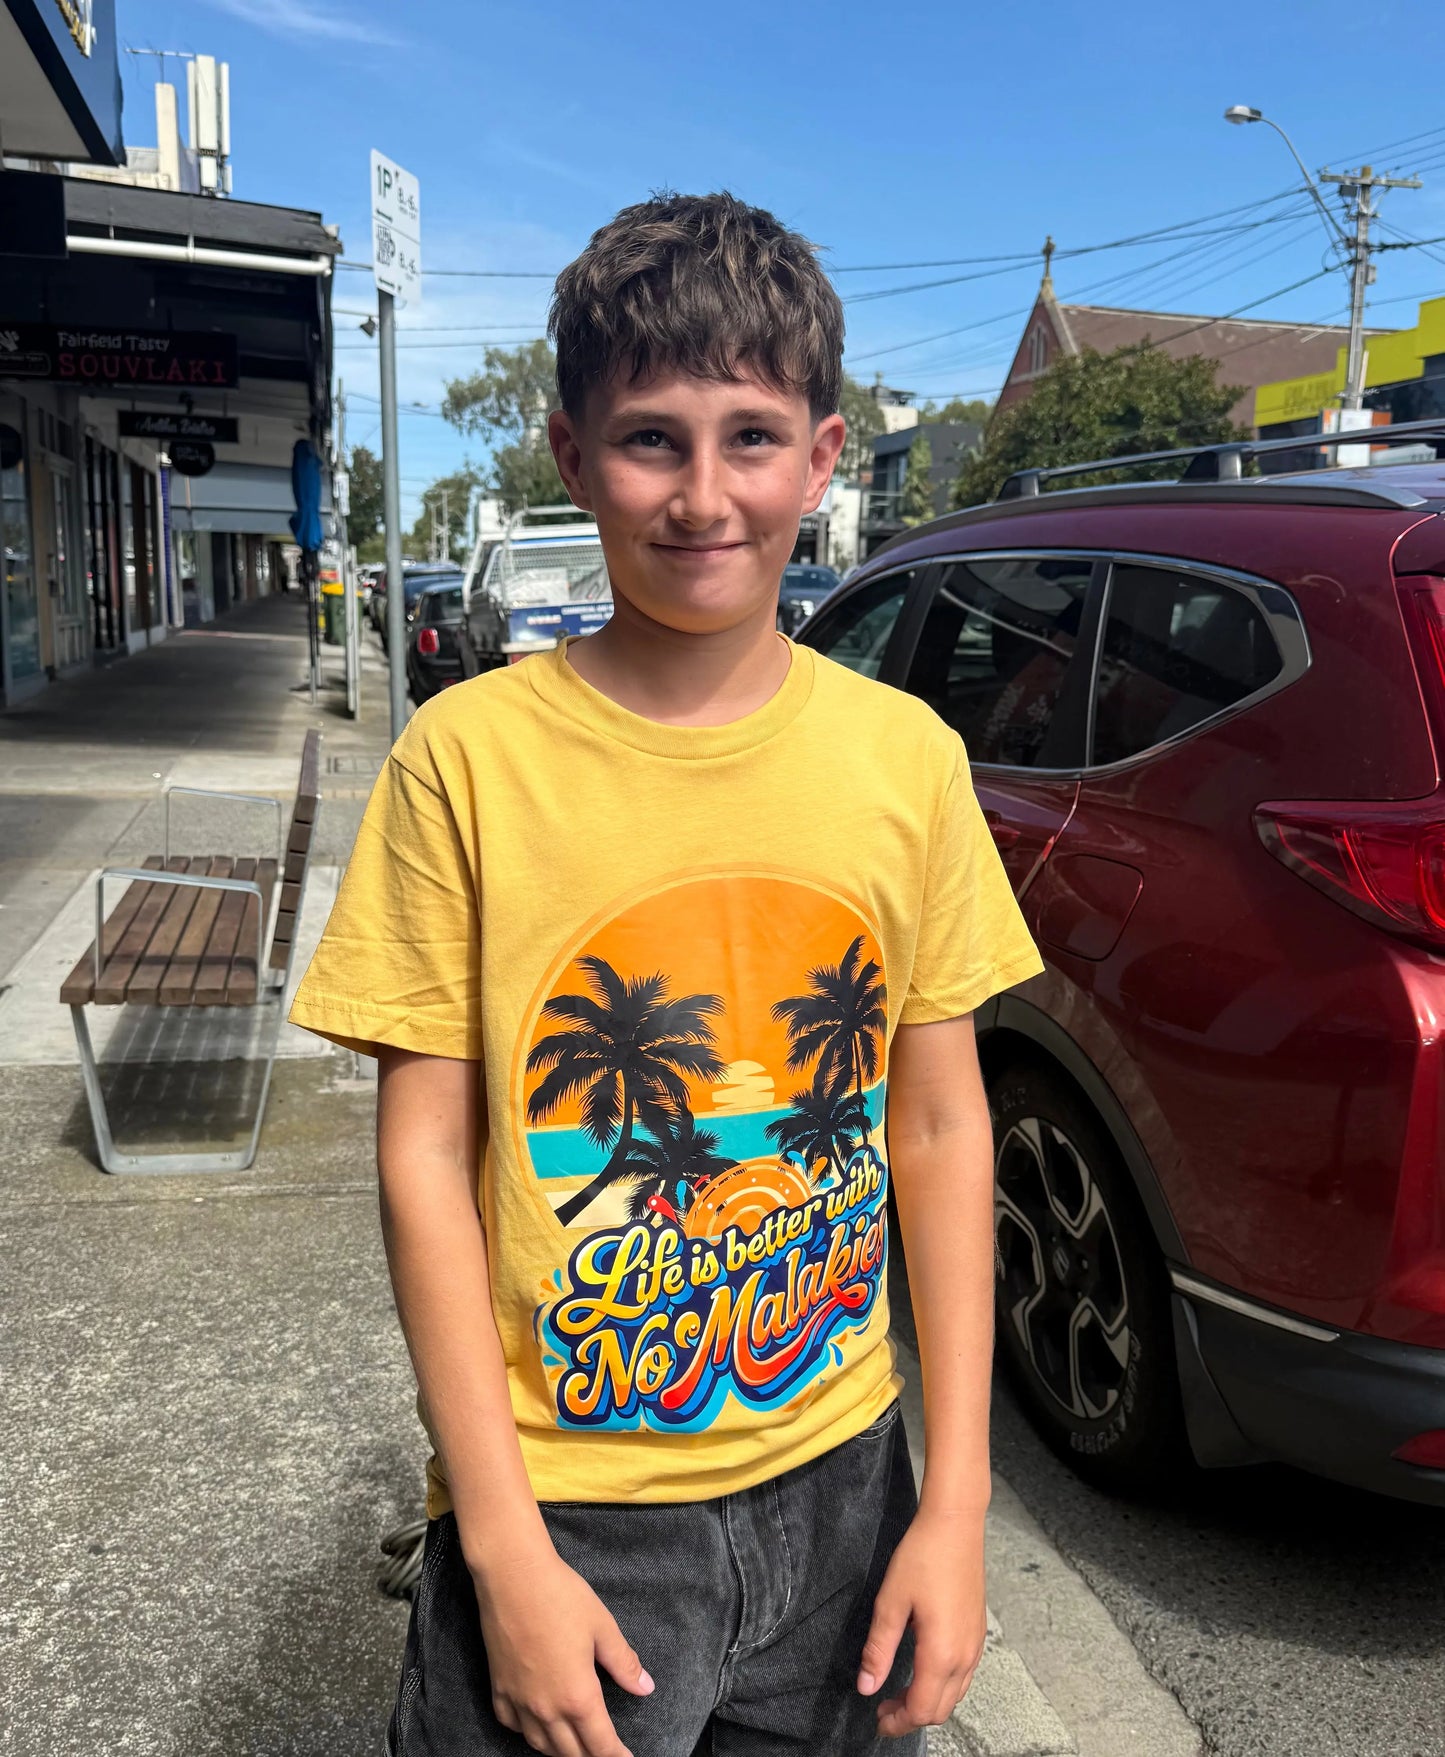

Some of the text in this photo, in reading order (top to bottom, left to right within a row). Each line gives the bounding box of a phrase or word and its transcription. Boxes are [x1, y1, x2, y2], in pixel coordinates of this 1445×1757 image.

[57, 331, 170, 353] Fairfield Tasty
[58, 353, 227, 383] SOUVLAKI
[556, 1150, 882, 1333] Life is better with
[564, 1318, 674, 1414] No
